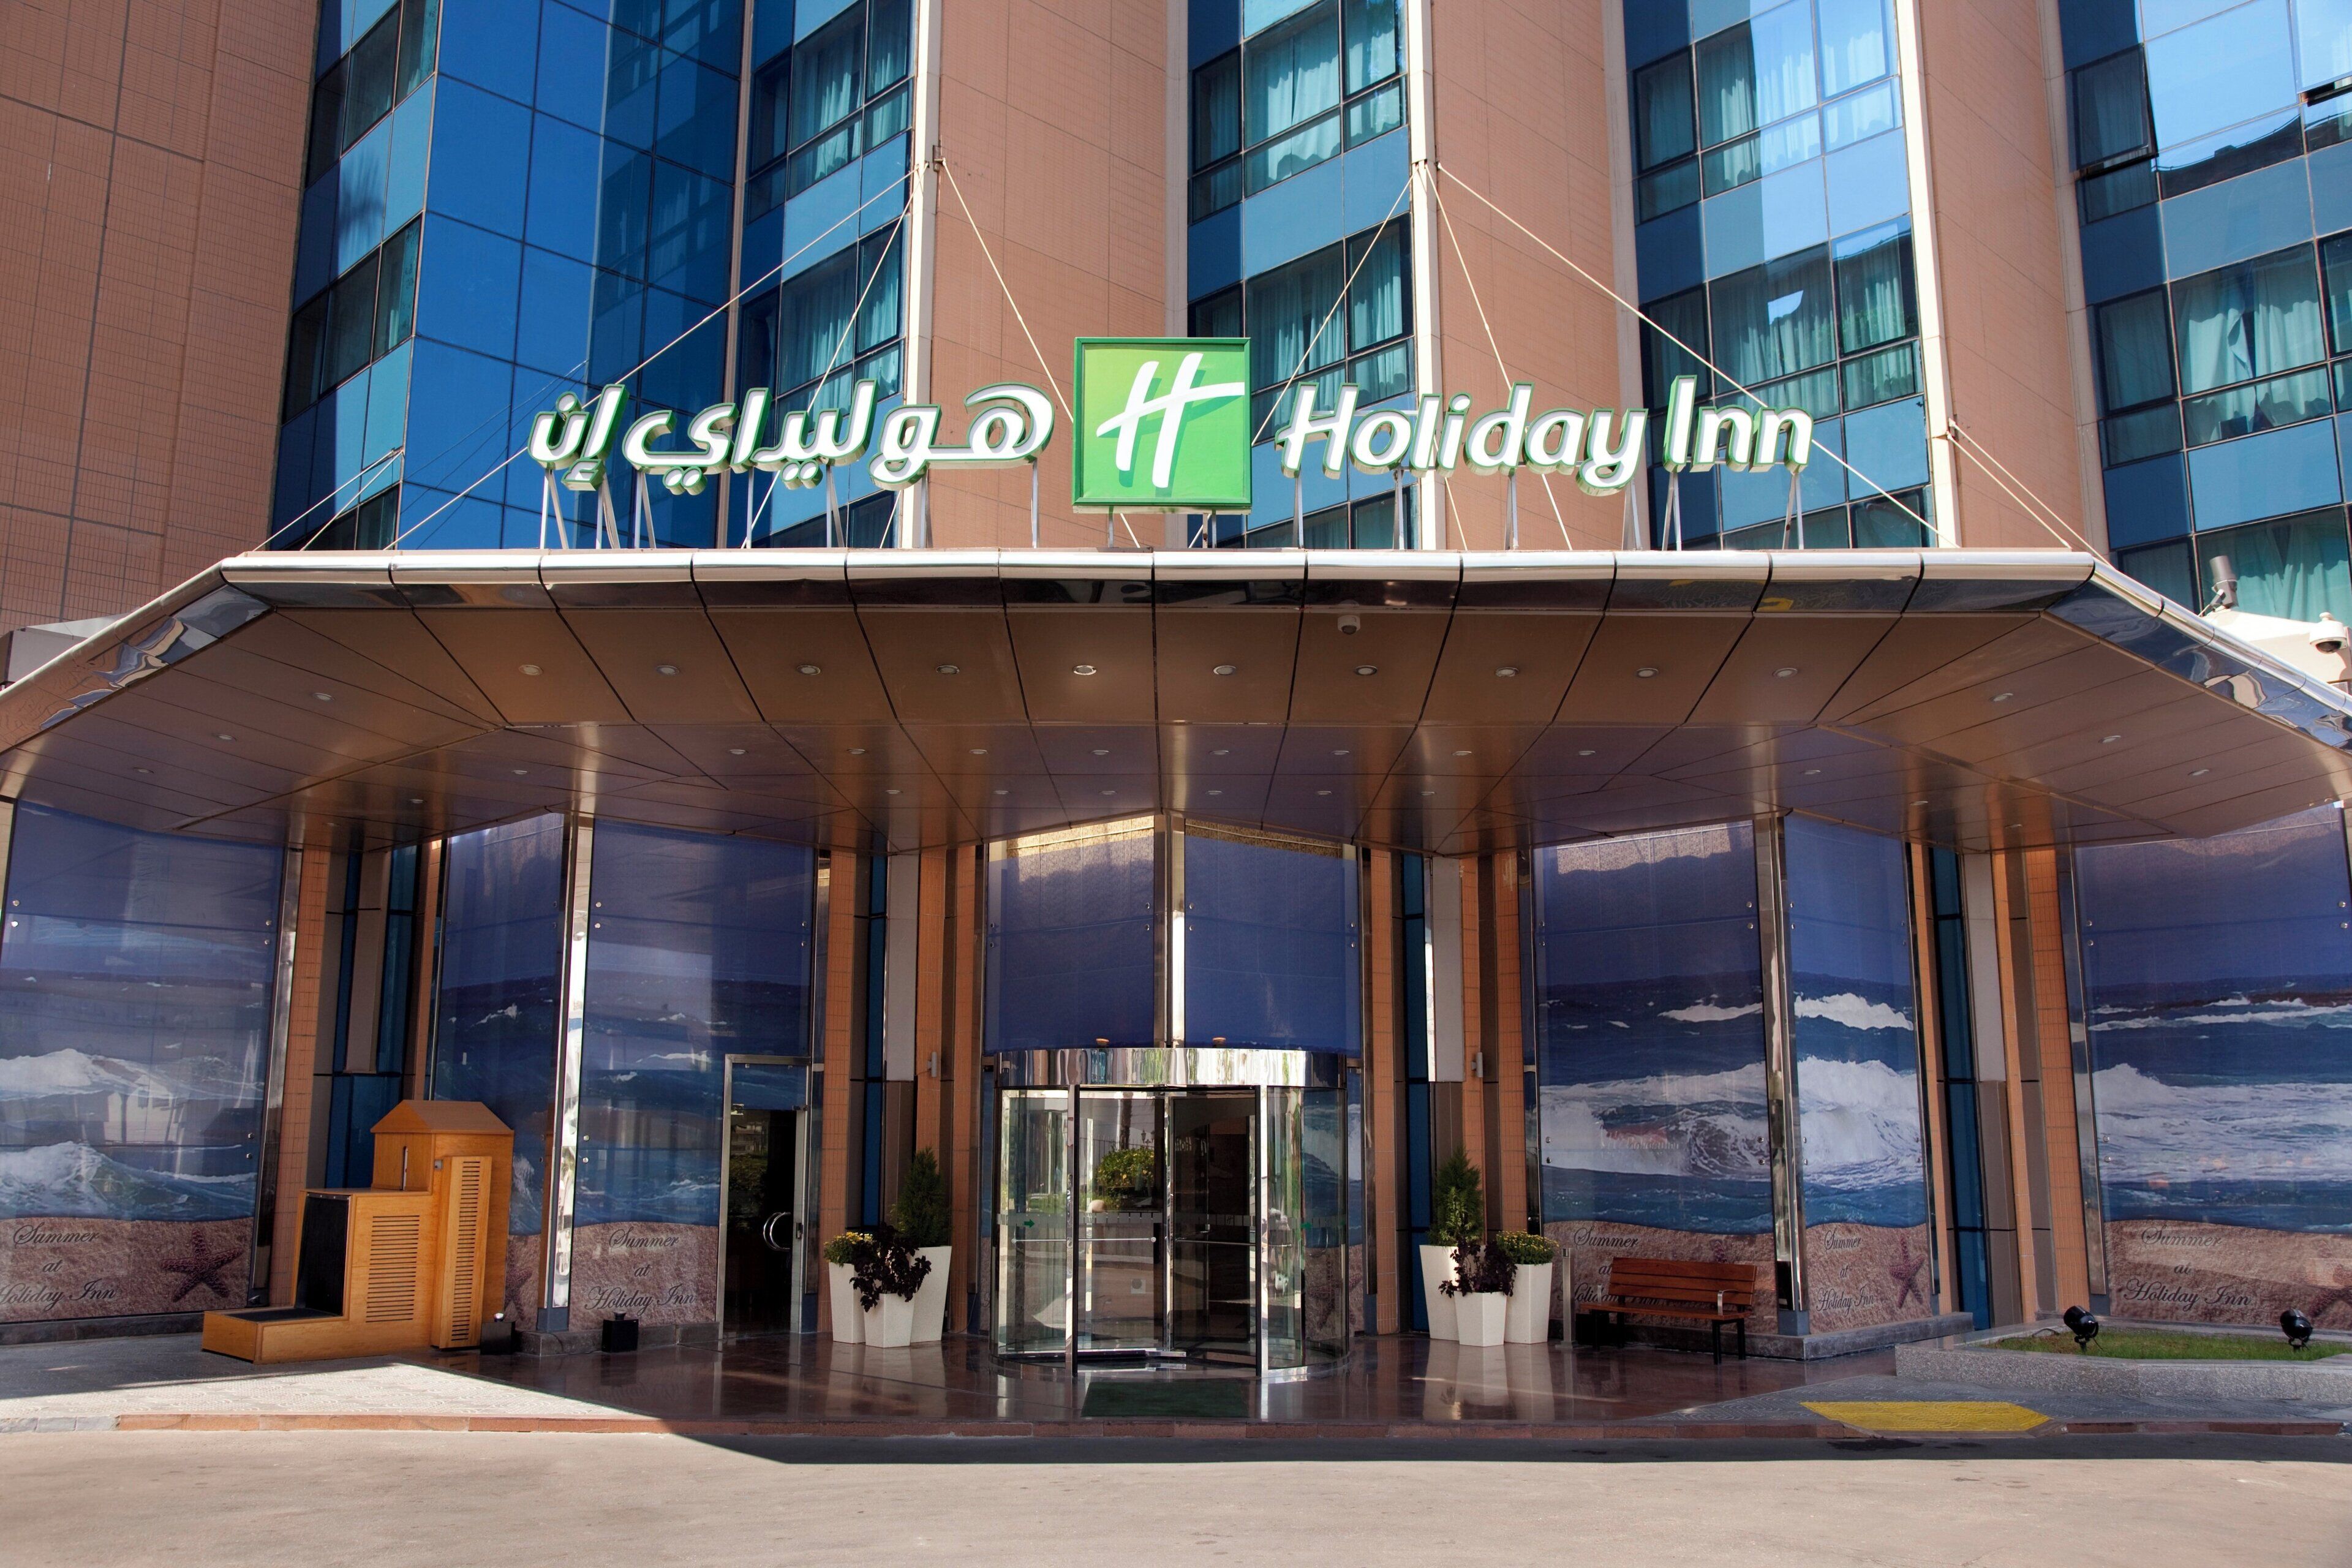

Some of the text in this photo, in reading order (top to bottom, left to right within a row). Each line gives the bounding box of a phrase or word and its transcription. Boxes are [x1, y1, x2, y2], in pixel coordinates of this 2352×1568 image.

[1096, 353, 1245, 488] H
[527, 379, 1055, 495] هوليداي إن
[1275, 375, 1814, 496] Holiday Inn
[13, 1222, 100, 1249] Summer
[609, 1226, 679, 1249] Summer
[1574, 1226, 1638, 1248] Summer
[1824, 1227, 1861, 1254] Summer
[2141, 1225, 2222, 1248] Summer
[42, 1260, 62, 1273] at
[634, 1264, 650, 1277] at
[1840, 1265, 1849, 1278] at
[2174, 1262, 2192, 1275] at
[69, 1278, 116, 1300] Inn
[584, 1284, 696, 1316] Holiday Inn
[1816, 1284, 1874, 1316] Holiday Inn
[2123, 1278, 2252, 1312] Holiday Inn
